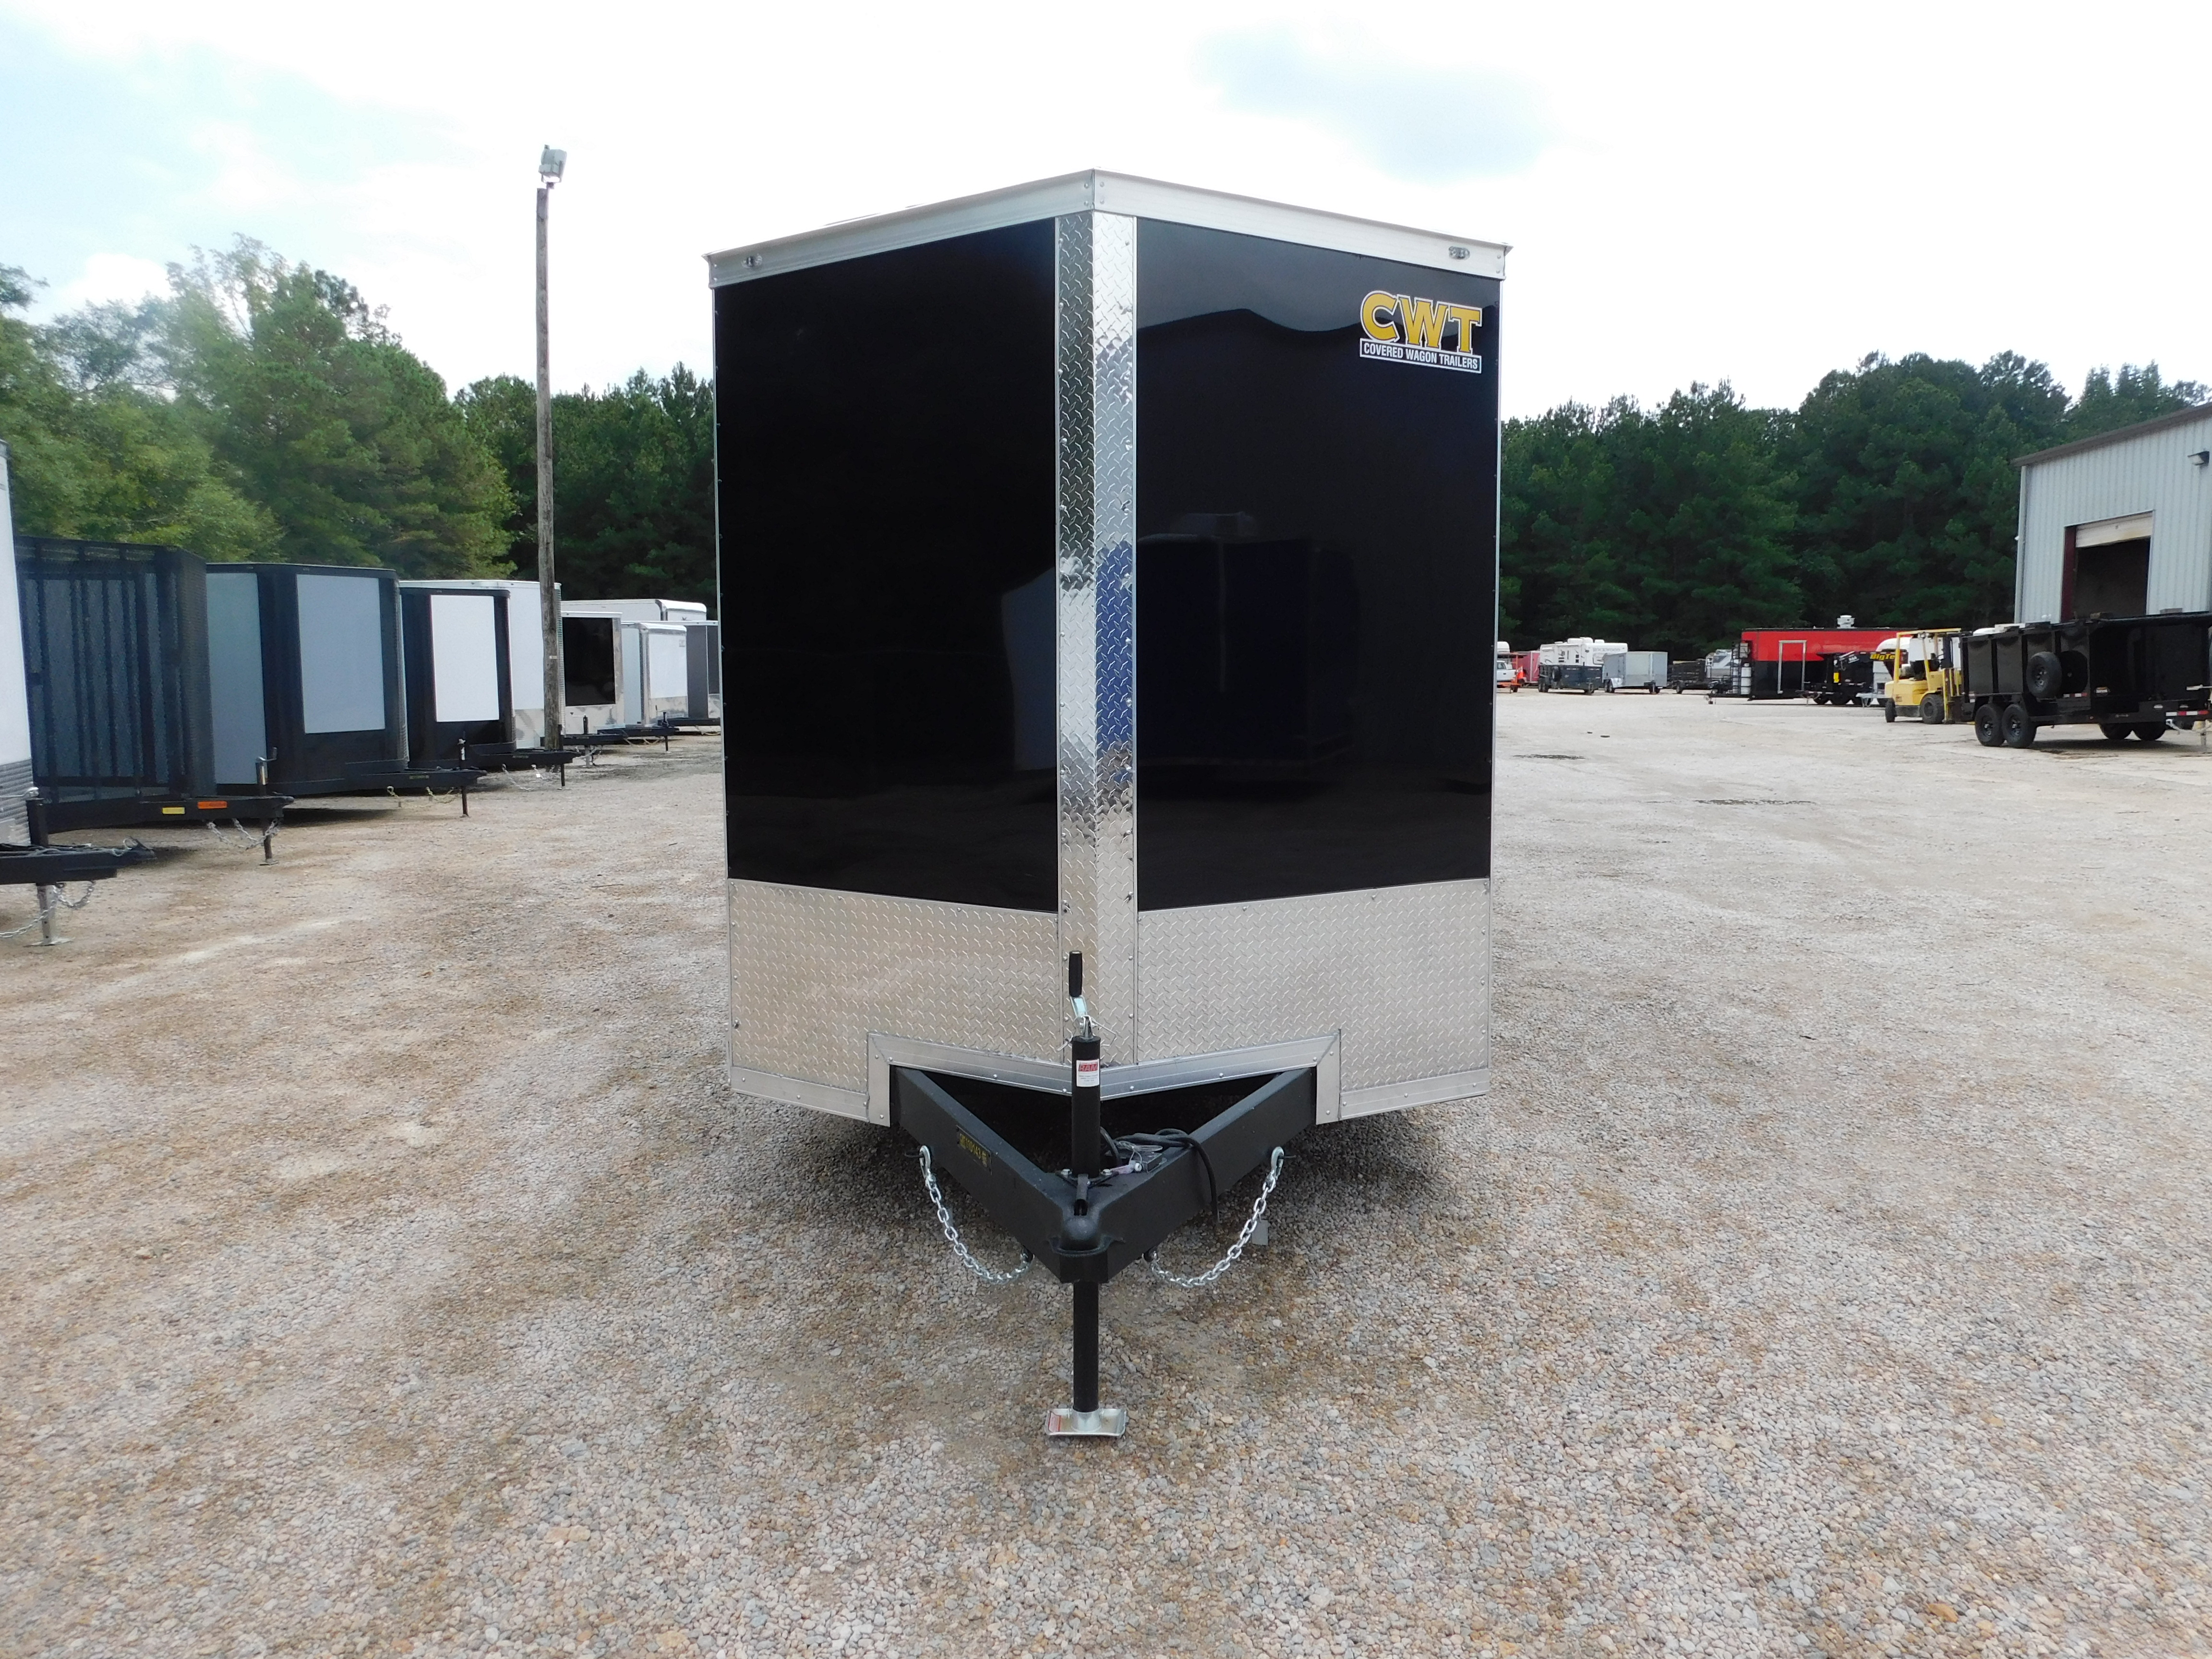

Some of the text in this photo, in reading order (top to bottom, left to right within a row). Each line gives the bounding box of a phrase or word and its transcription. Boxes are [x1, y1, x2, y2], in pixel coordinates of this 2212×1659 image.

[1360, 290, 1482, 354] CWT
[1364, 342, 1478, 370] COVERED WAGON TRAILERS
